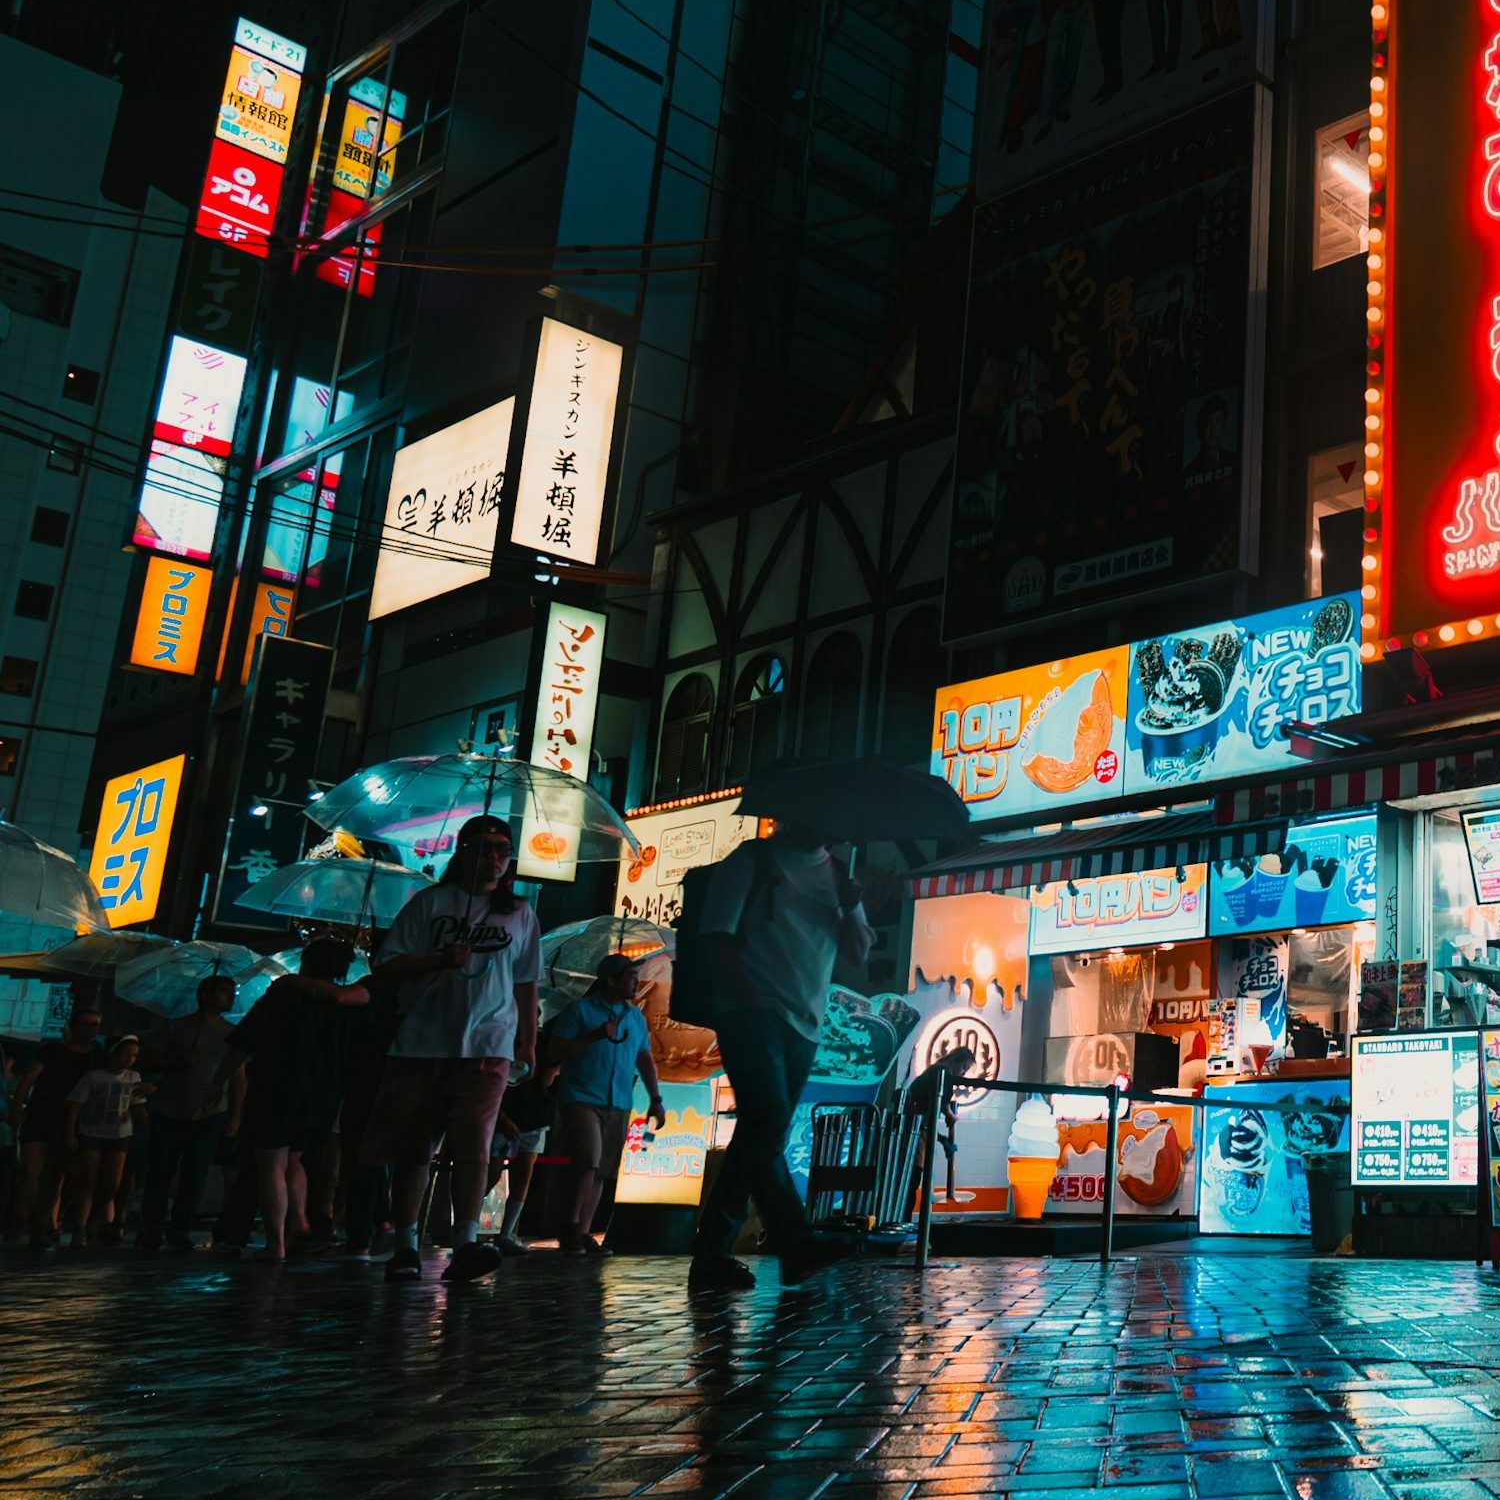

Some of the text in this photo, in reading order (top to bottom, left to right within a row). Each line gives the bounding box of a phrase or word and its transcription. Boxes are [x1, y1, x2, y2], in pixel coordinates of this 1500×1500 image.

[226, 91, 288, 131] 情報館
[210, 175, 269, 215] アコム
[563, 338, 591, 440] ジンギスカン
[153, 568, 195, 664] プロミス
[1252, 629, 1312, 666] NEW
[1277, 650, 1350, 700] チョコ
[940, 695, 1023, 759] 10円
[1153, 757, 1185, 771] NEW
[111, 776, 162, 845] プロ
[100, 846, 150, 909] ミス
[1056, 873, 1184, 928] 10円パン
[1243, 973, 1279, 989] チュロス
[1250, 957, 1278, 972] チョコ
[1362, 1039, 1443, 1054] STANDARD TAKOYAKI
